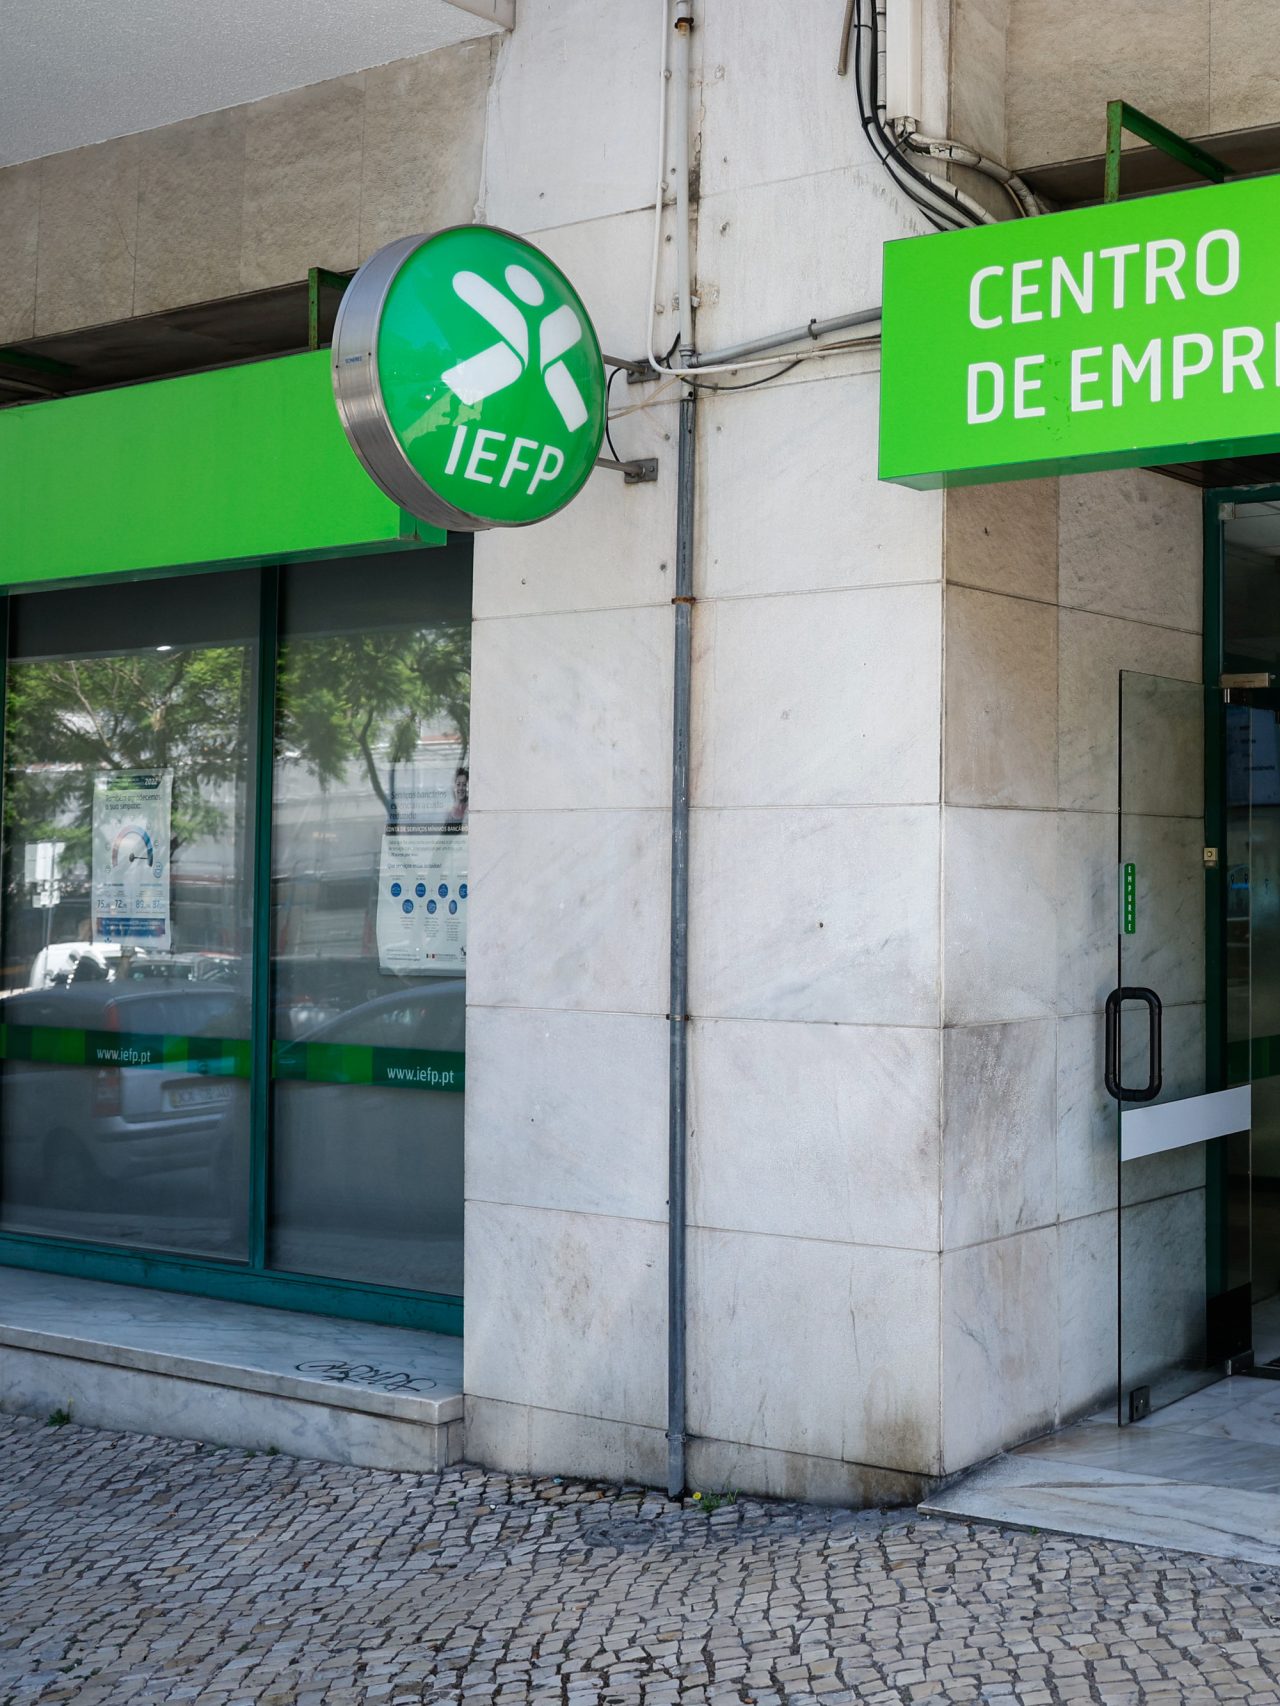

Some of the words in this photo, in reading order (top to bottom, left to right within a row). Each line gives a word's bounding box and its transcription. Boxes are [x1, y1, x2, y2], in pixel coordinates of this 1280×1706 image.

[968, 229, 1240, 329] CENTRO
[967, 354, 1046, 425] DE
[444, 424, 565, 496] IEFP
[96, 1048, 151, 1065] www.iefp.pt
[387, 1066, 455, 1087] www.iefp.pt
